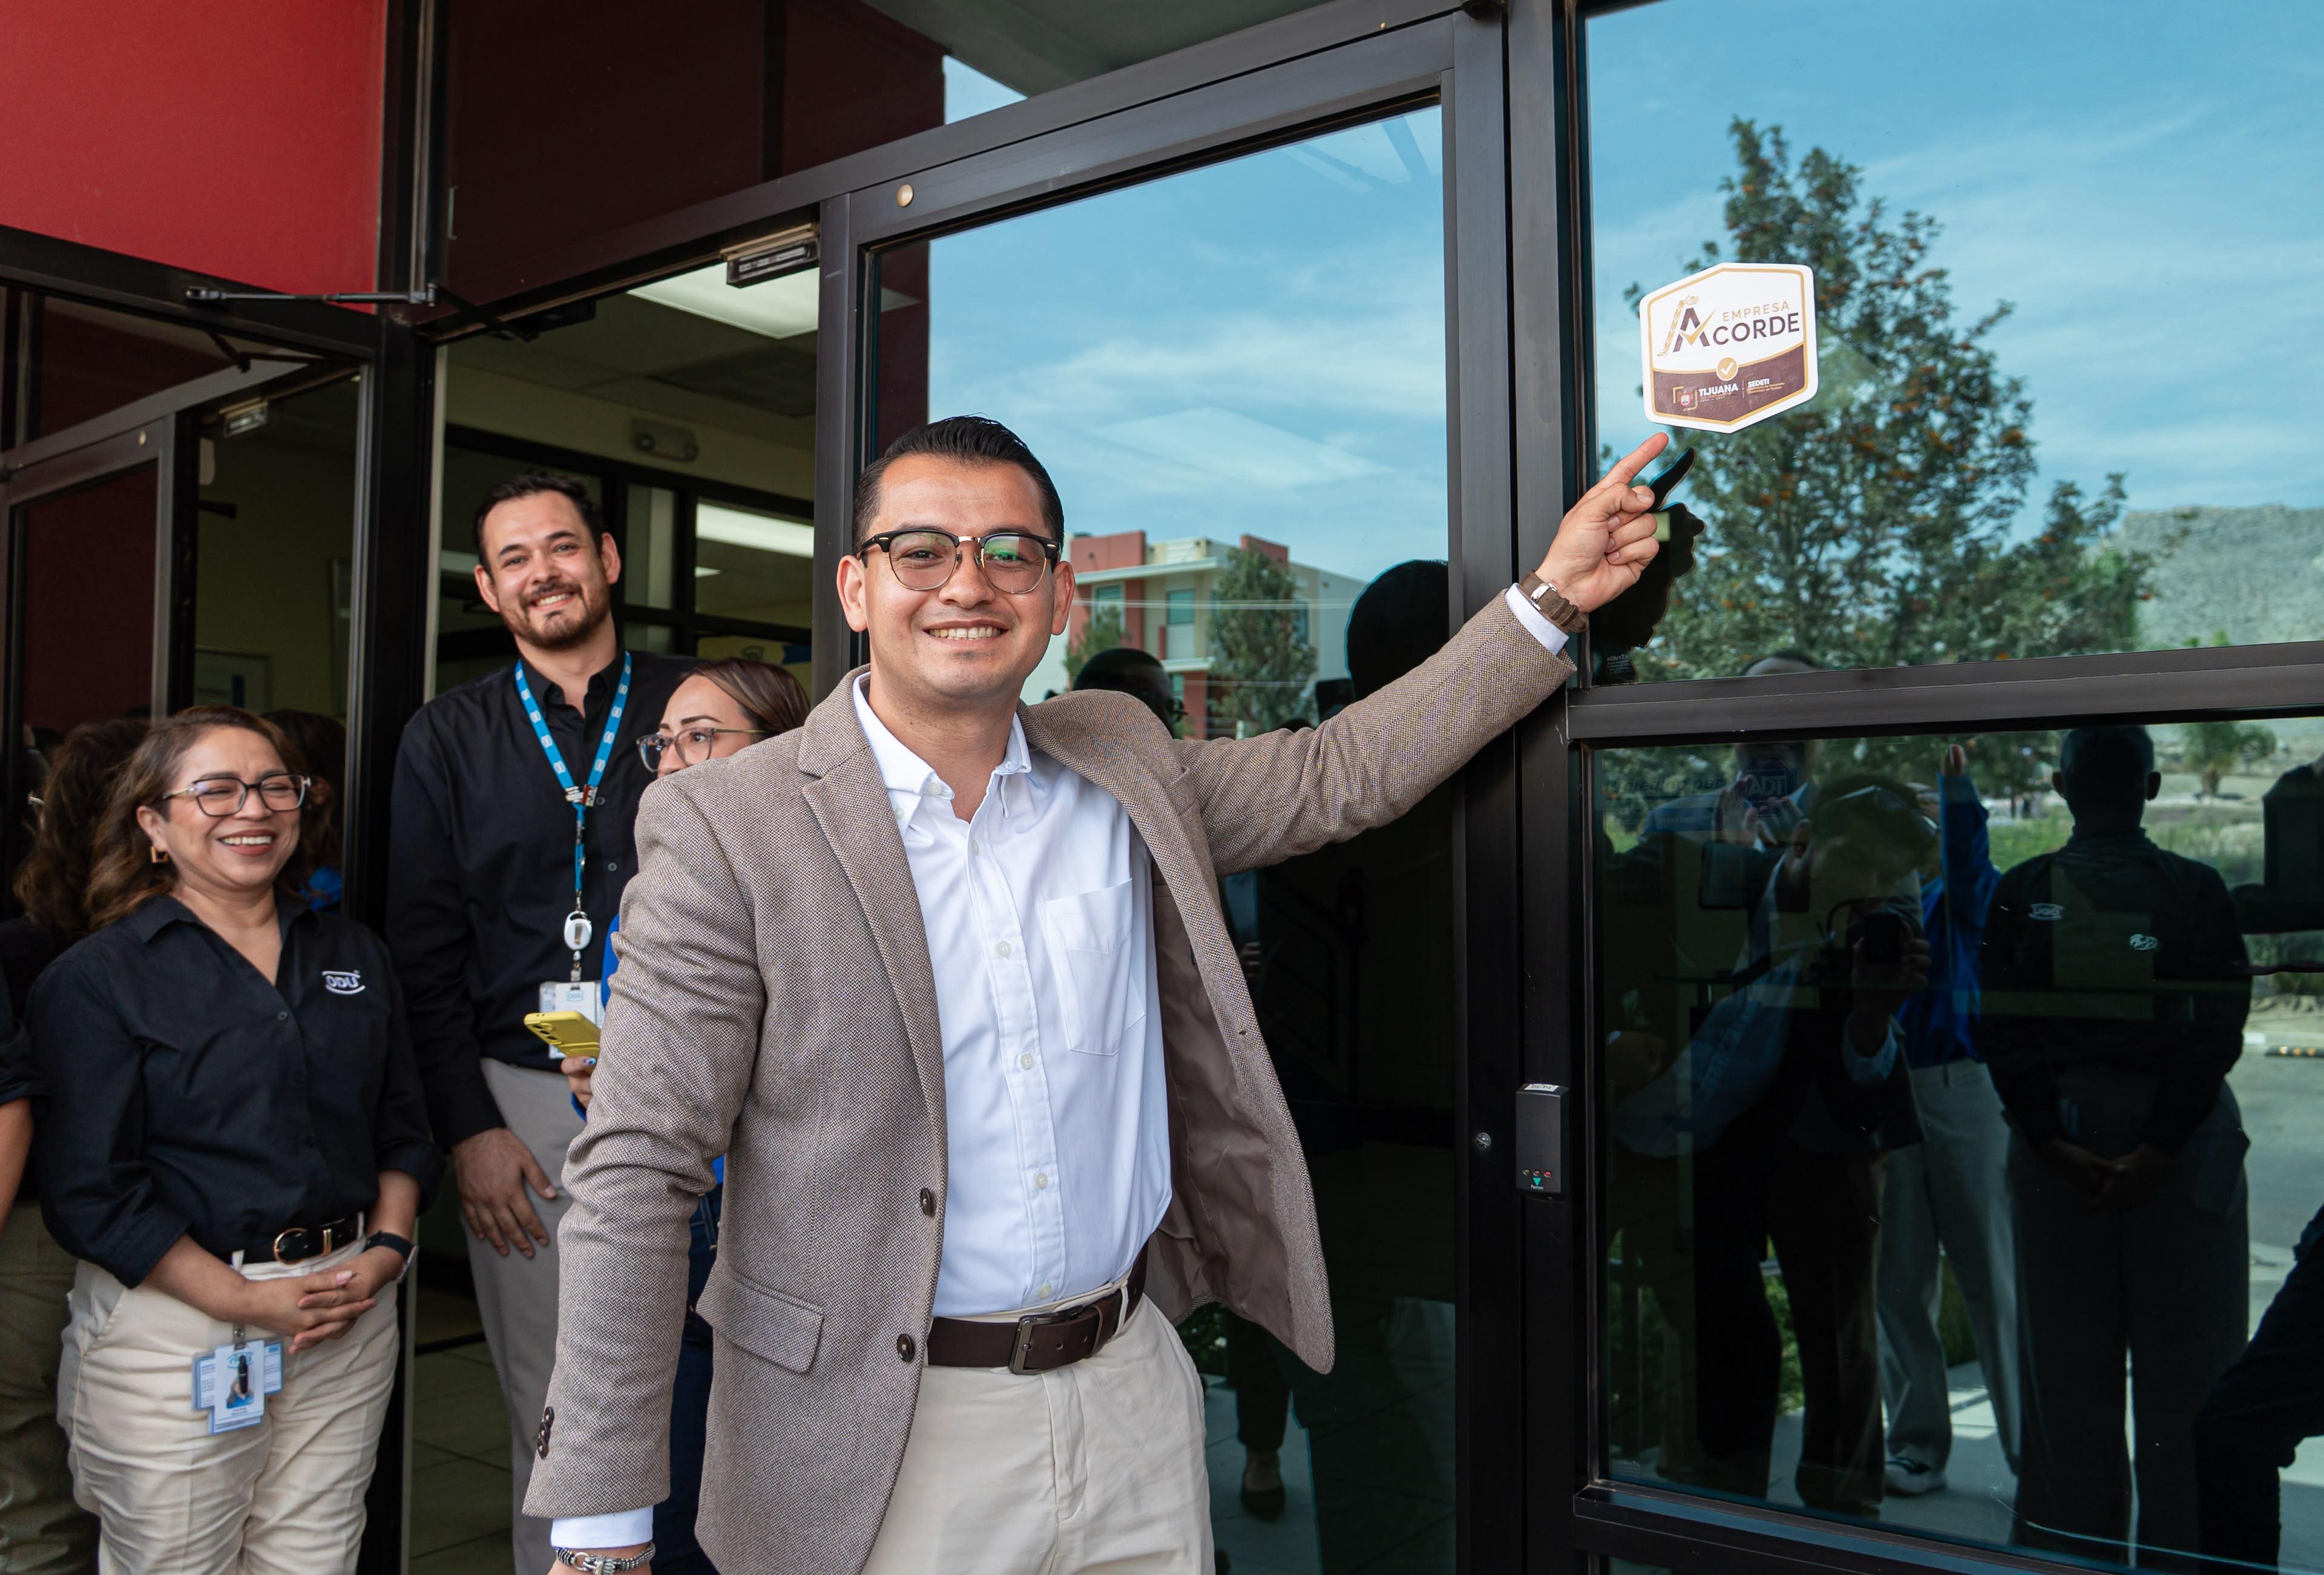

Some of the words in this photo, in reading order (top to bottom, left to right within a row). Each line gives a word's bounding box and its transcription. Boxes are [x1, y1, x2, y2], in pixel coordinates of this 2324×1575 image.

[1723, 301, 1790, 322] EMPRESA
[1699, 383, 1739, 397] TIJUANA
[1747, 378, 1770, 388] SEDETI
[1747, 774, 1785, 796] ADT
